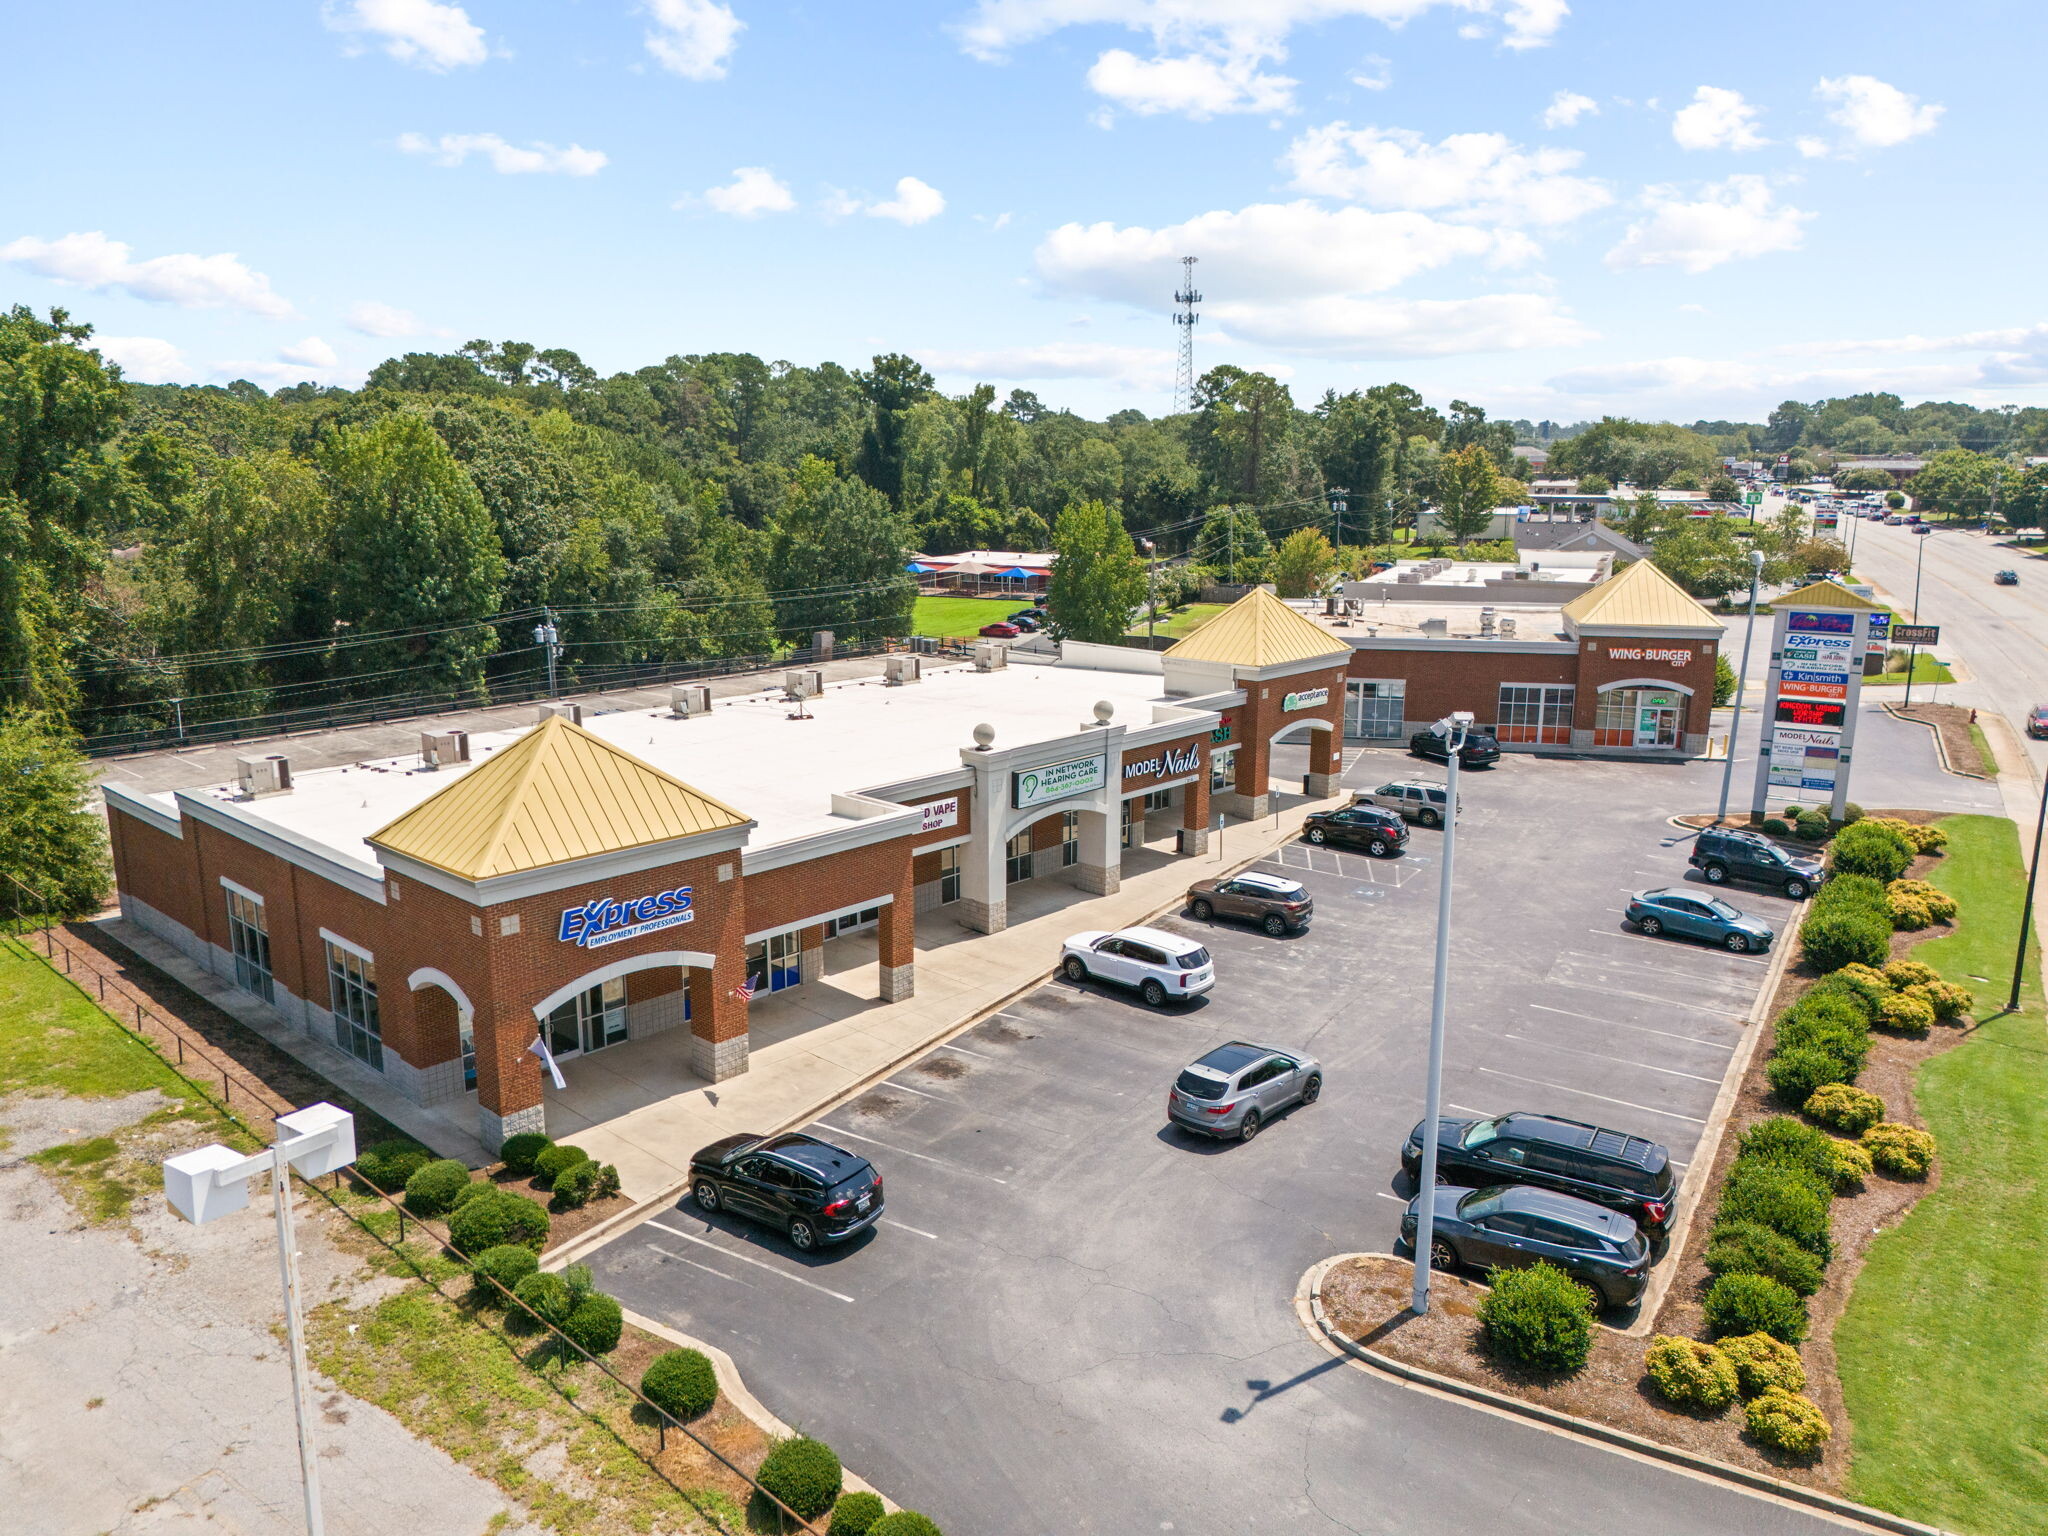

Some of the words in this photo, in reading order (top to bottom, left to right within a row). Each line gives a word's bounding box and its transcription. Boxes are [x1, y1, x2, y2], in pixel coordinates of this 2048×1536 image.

[1749, 494, 1761, 503] TD
[1895, 626, 1936, 638] CrossFit
[1793, 652, 1815, 660] CASH
[1779, 731, 1806, 740] MODEL
[1803, 733, 1834, 745] Nails
[1125, 758, 1161, 778] MODEL
[1156, 743, 1200, 778] Nails
[1045, 769, 1054, 777] IN
[1055, 760, 1095, 774] NETWORK
[1041, 771, 1077, 787] HEARING
[1078, 767, 1098, 777] CARE
[933, 801, 956, 816] VAPE
[922, 819, 943, 830] SHOP
[589, 927, 639, 948] EMPLOYMENT
[640, 912, 692, 934] PROFESSIONALS
